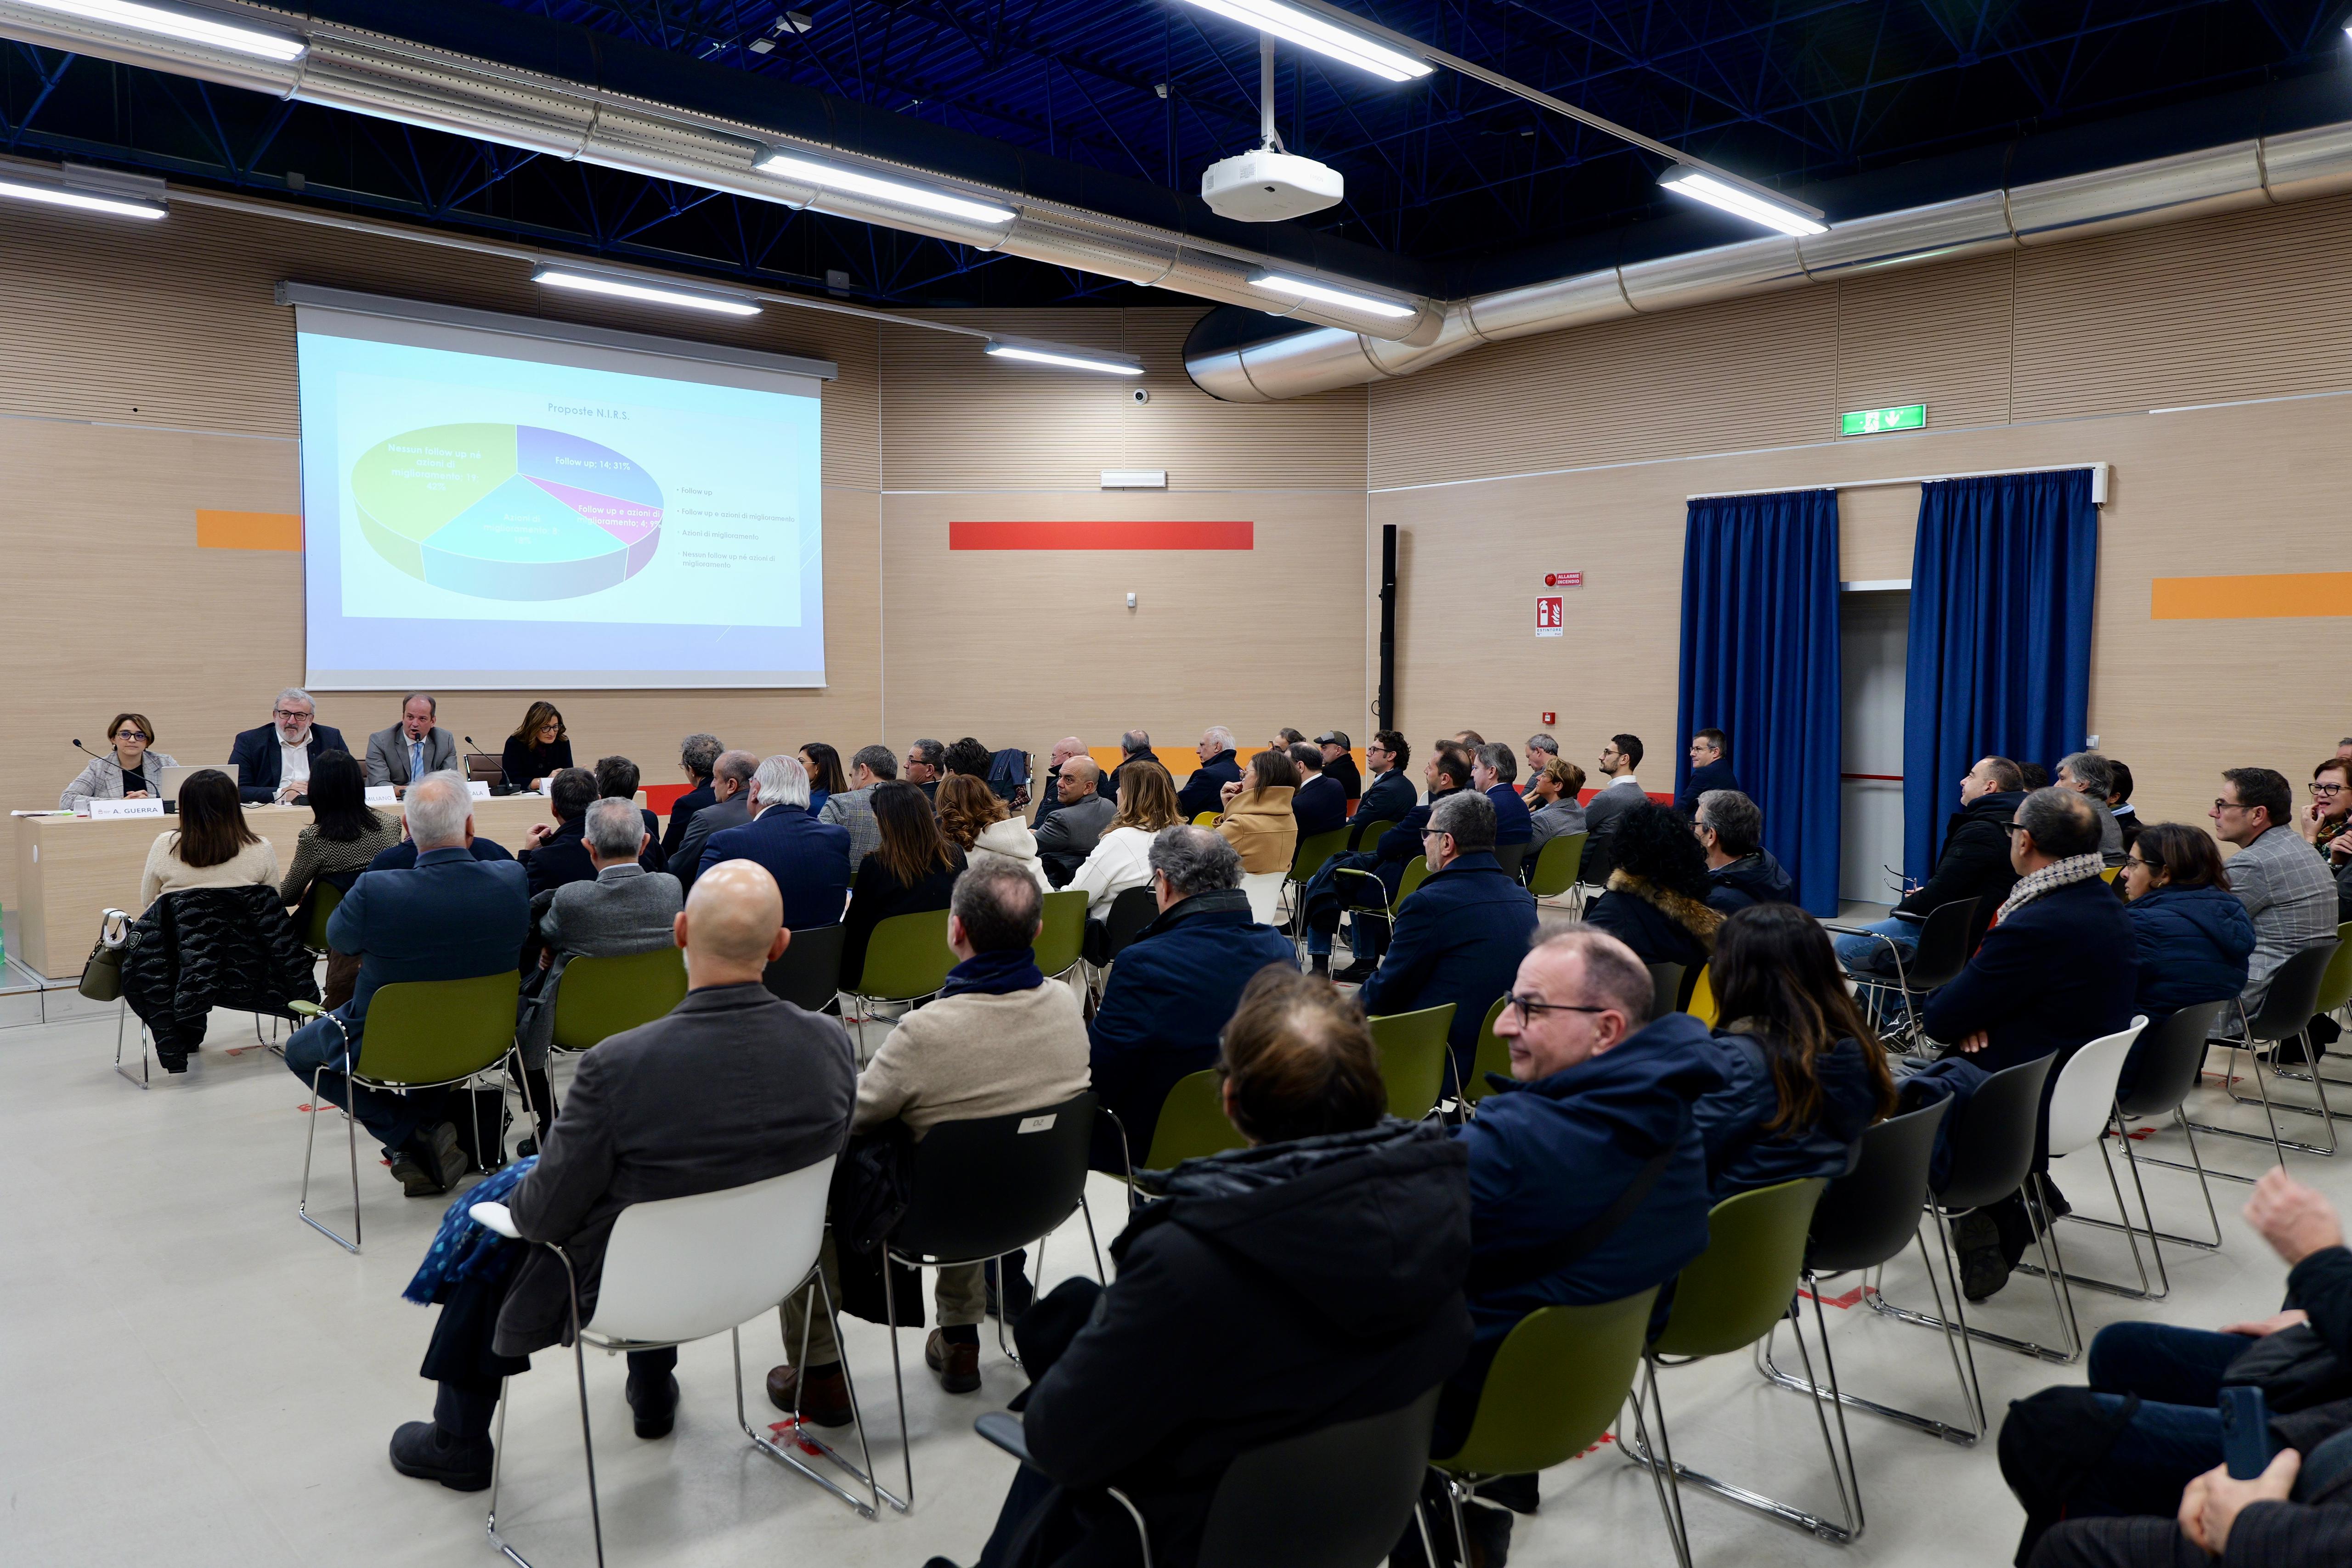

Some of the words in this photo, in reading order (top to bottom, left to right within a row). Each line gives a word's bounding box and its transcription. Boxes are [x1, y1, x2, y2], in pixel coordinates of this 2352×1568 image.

[548, 403, 594, 416] Proposte
[597, 408, 630, 420] N.I.R.S.
[388, 443, 423, 454] Nessun
[425, 446, 452, 457] follow
[470, 451, 481, 459] né
[416, 458, 444, 468] azioni
[447, 460, 455, 468] di
[555, 456, 582, 466] Follow
[600, 461, 611, 469] 14;
[614, 462, 630, 470] 31%
[427, 482, 447, 491] 42%
[578, 505, 604, 513] Follow
[503, 513, 530, 522] Azioni
[577, 516, 639, 528] miglioramento;
[640, 520, 648, 528] 4;
[749, 513, 795, 522] miglioramento
[712, 531, 759, 540] miglioramento
